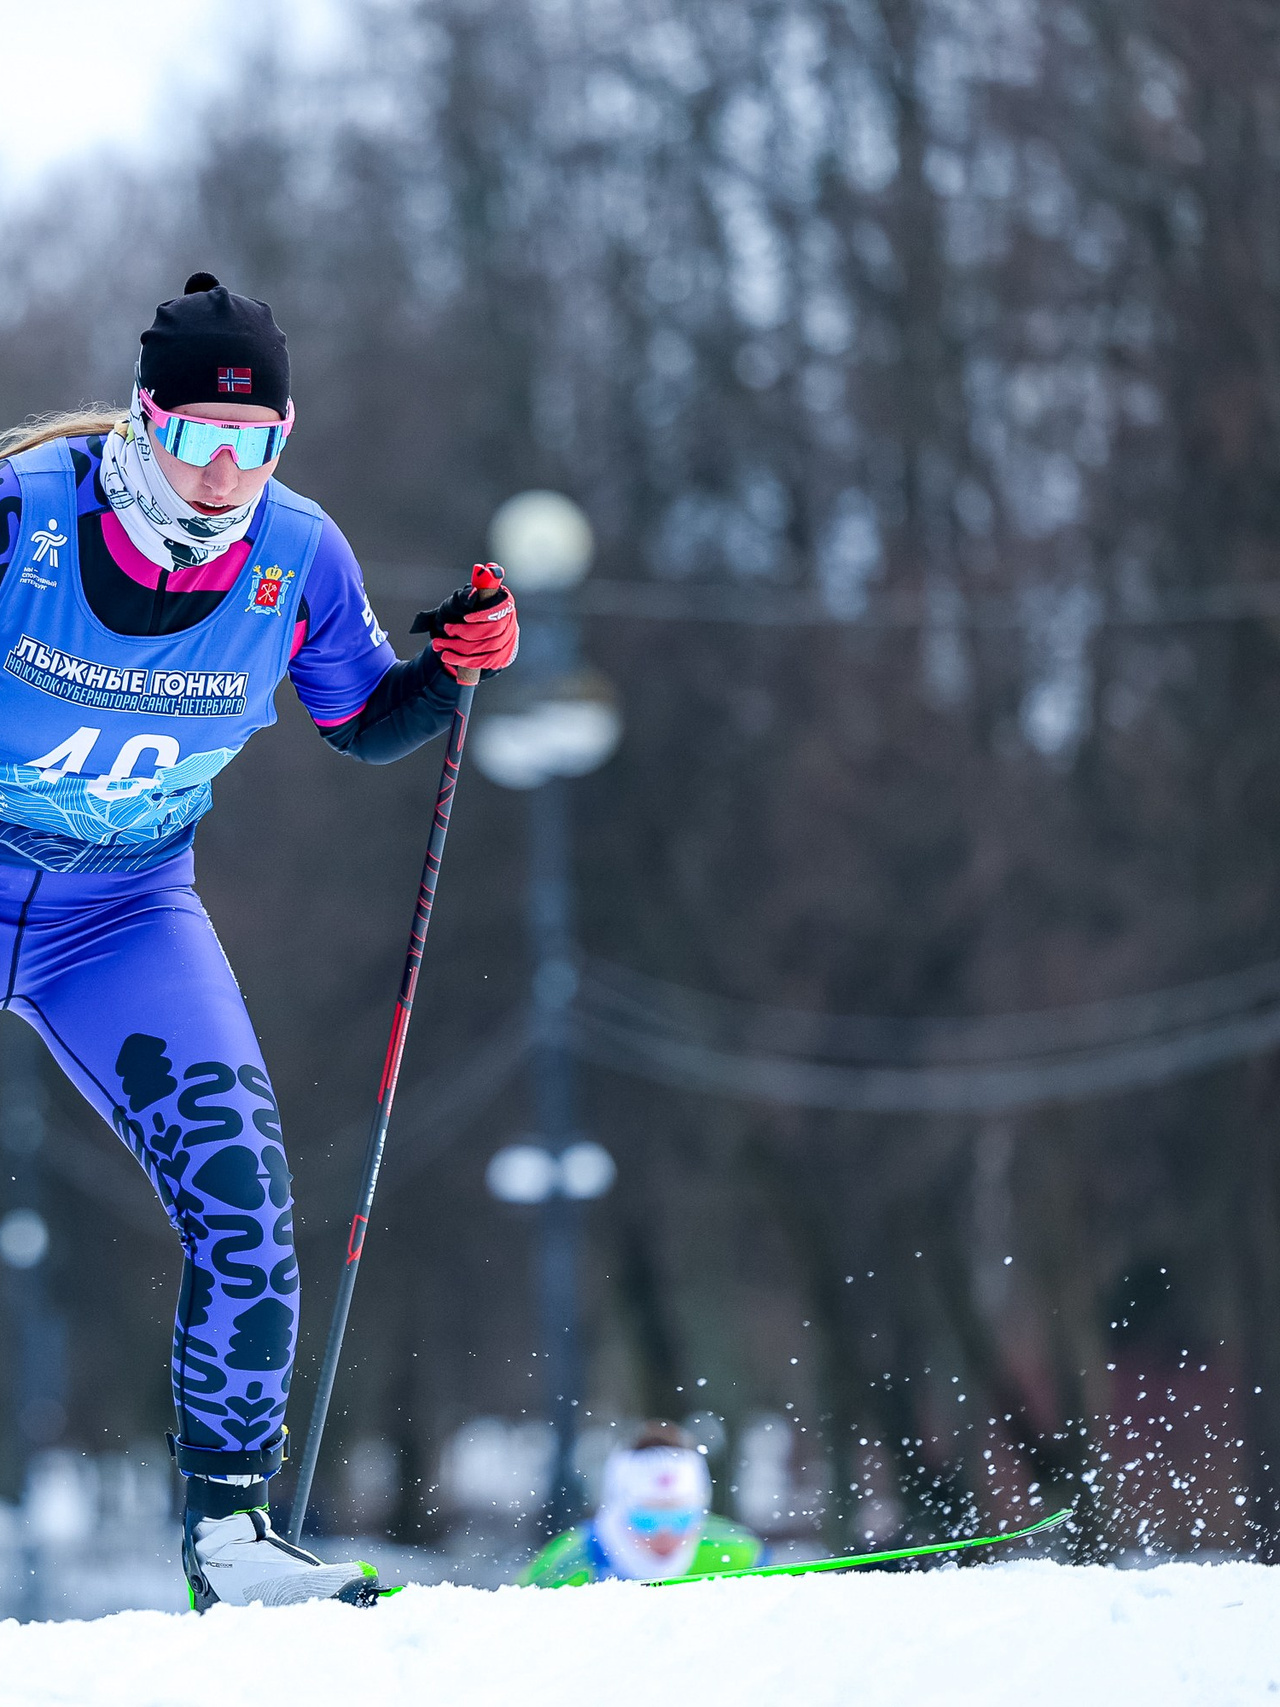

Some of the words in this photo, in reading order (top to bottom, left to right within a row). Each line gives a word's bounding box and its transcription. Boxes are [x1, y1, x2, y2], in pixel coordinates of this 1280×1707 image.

[6, 655, 21, 674] НА
[22, 664, 60, 693] КУБОК
[58, 682, 139, 710] ГУБЕРНАТОРА
[140, 695, 245, 714] САНКТ-ПЕТЕРБУРГА
[16, 638, 145, 693] ЛЫЖНЫЕ
[152, 672, 246, 697] ГОНКИ
